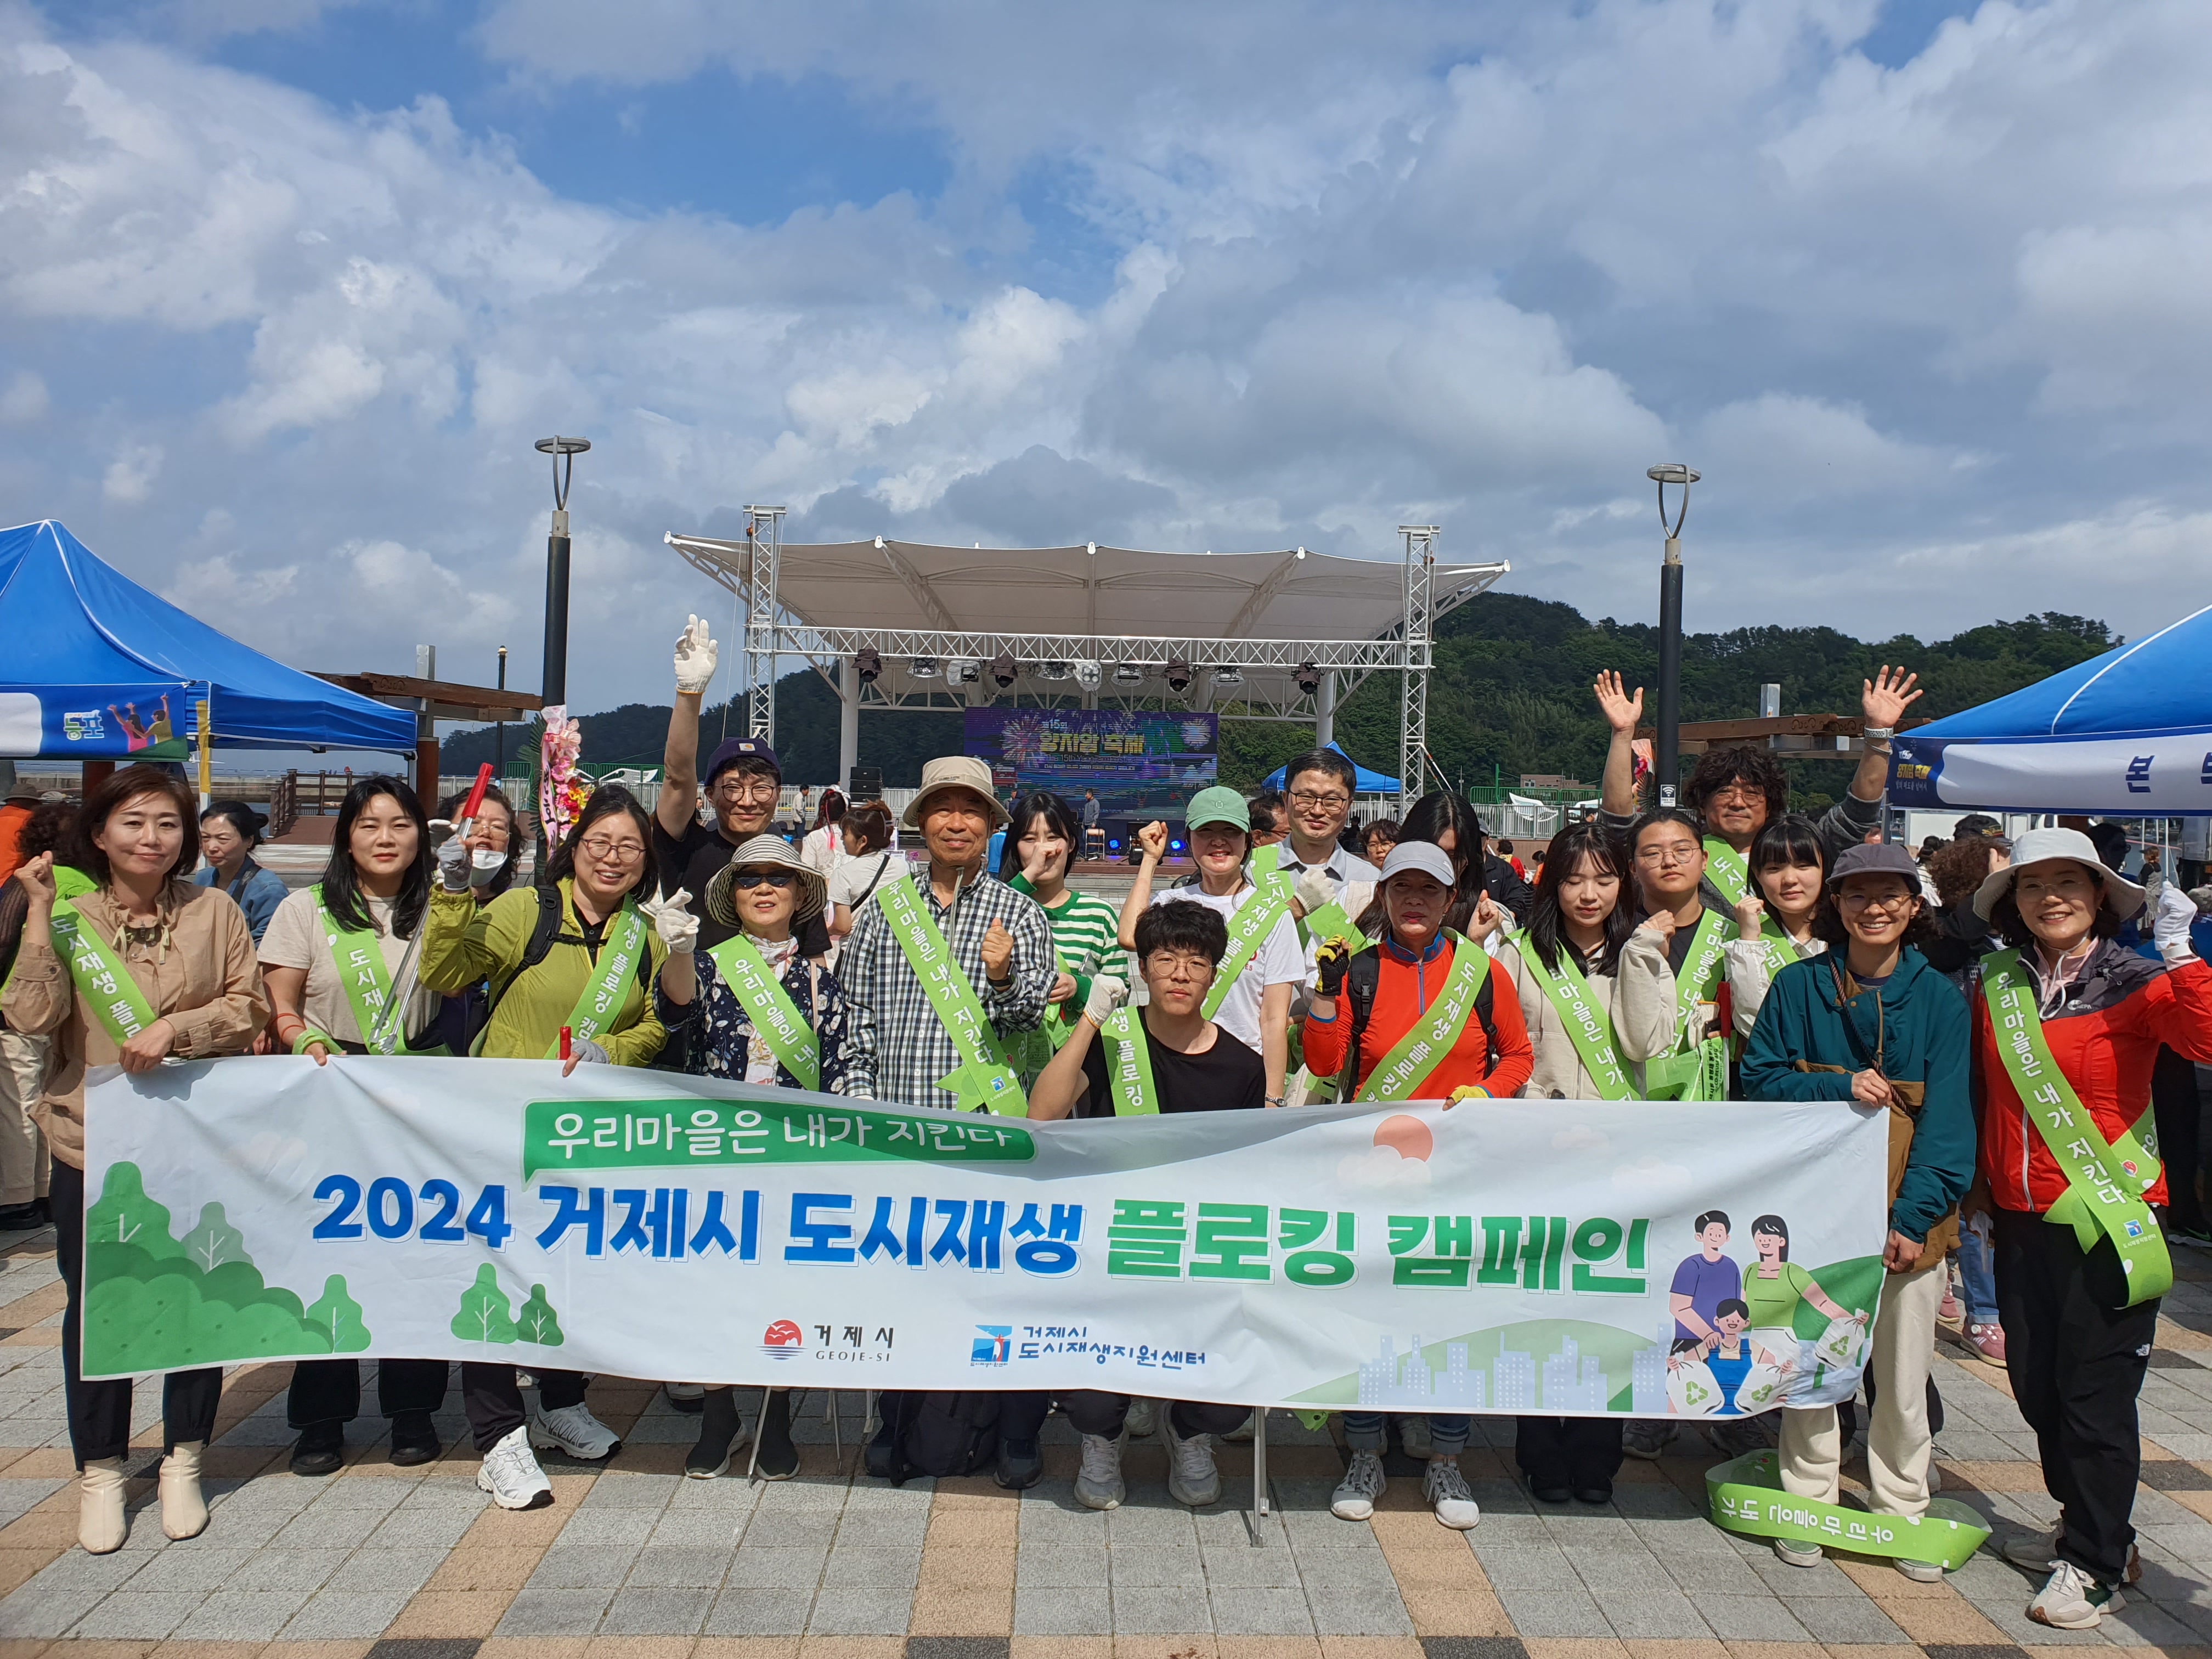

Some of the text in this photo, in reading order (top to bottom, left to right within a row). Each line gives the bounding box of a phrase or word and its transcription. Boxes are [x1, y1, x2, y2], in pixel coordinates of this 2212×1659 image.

[50, 918, 117, 995] 도시재생
[595, 952, 629, 1014] 플로킹
[888, 882, 994, 1063] 우리마을은 내가 지킨다
[735, 959, 799, 1046] 우리마을은
[1381, 961, 1476, 1096] 도시재생 플로킹
[1117, 1040, 1143, 1107] 플로킹
[1595, 1045, 1625, 1086] 내가
[1996, 972, 2126, 1205] 우리마을은 내가 지킨다
[548, 1109, 1012, 1159] 우리마을은 내가 지킨다
[313, 1174, 1652, 1299] 2024 거제시 도시재생 플로킹 캠페인
[816, 1350, 890, 1362] GEOJE-SI
[1018, 1342, 1206, 1370] 도시재생지원센터
[1022, 1325, 1087, 1339] 거제시
[1720, 1496, 1759, 1521] 내가
[1769, 1503, 1894, 1544] 우리마을은
